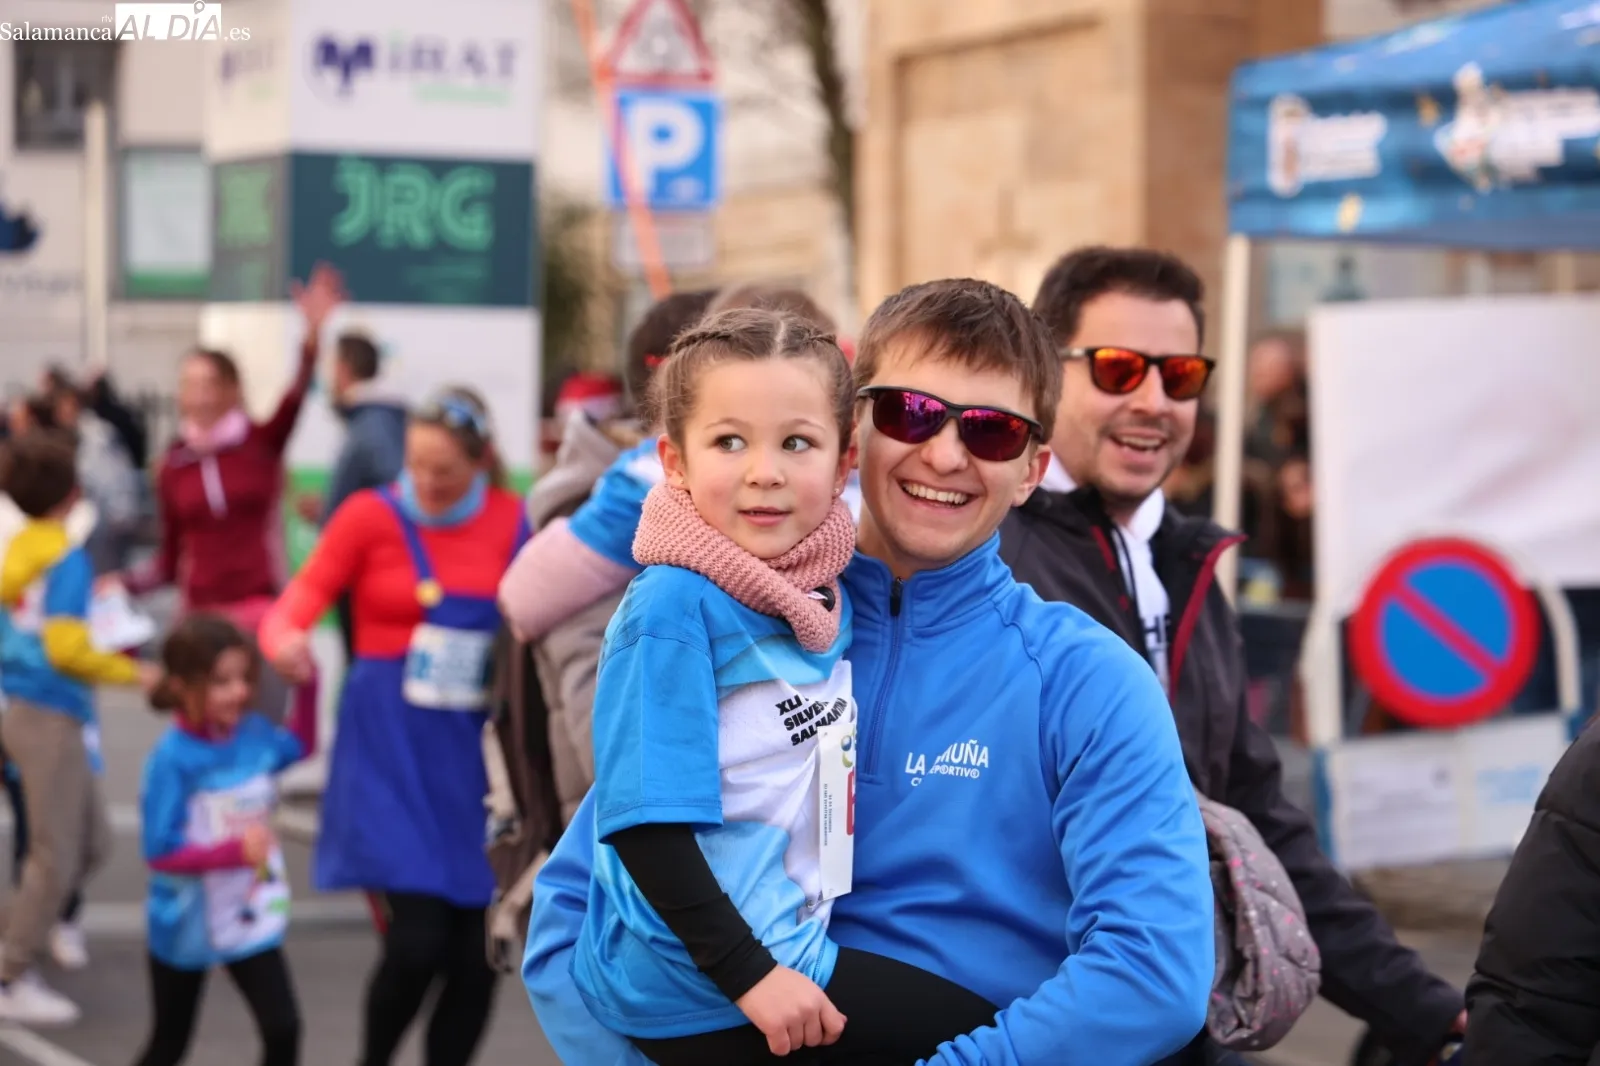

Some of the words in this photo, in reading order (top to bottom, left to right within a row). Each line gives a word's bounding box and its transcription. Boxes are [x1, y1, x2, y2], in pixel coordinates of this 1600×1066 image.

[628, 101, 706, 202] P
[333, 155, 496, 250] JRG
[905, 752, 926, 776] LA
